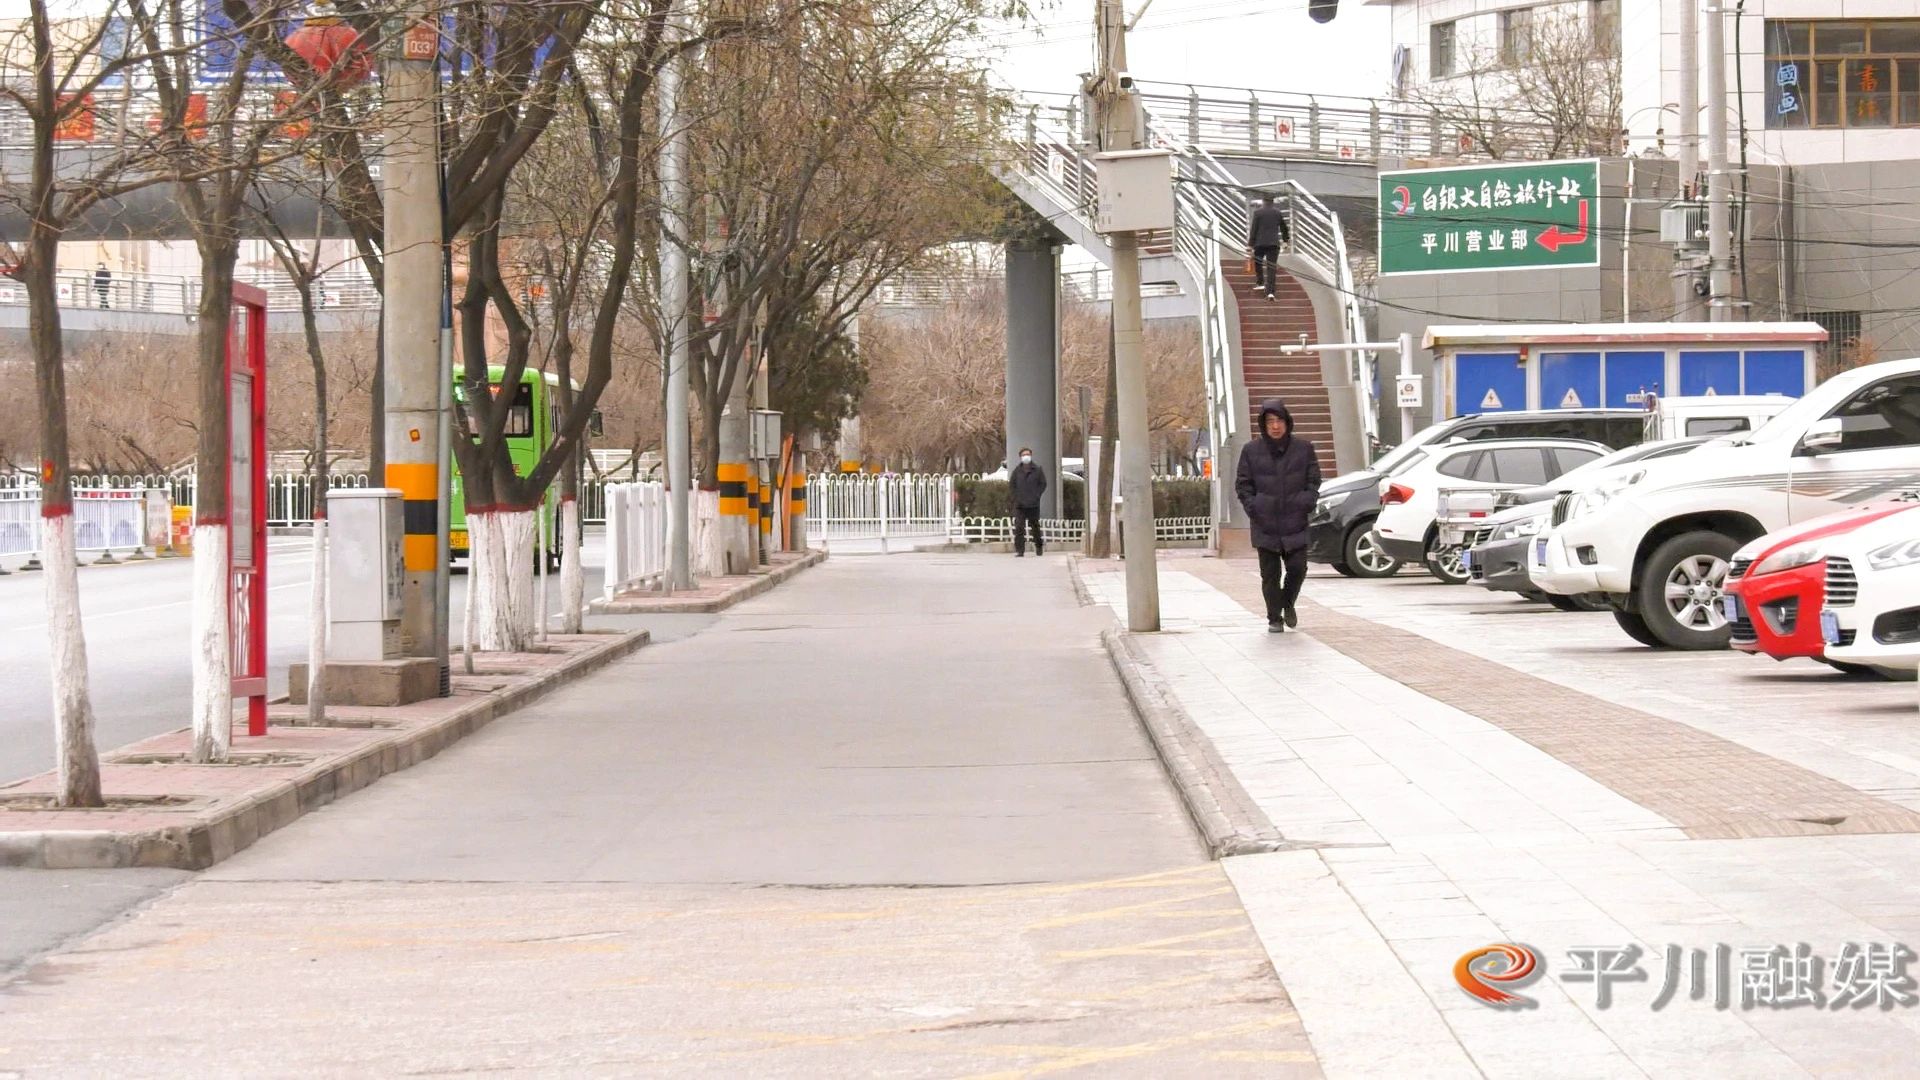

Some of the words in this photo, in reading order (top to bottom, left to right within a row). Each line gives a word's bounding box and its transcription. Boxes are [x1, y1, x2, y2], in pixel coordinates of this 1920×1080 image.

[1422, 177, 1581, 211] 白银大自然旅行社
[1421, 229, 1528, 254] 平川营业部
